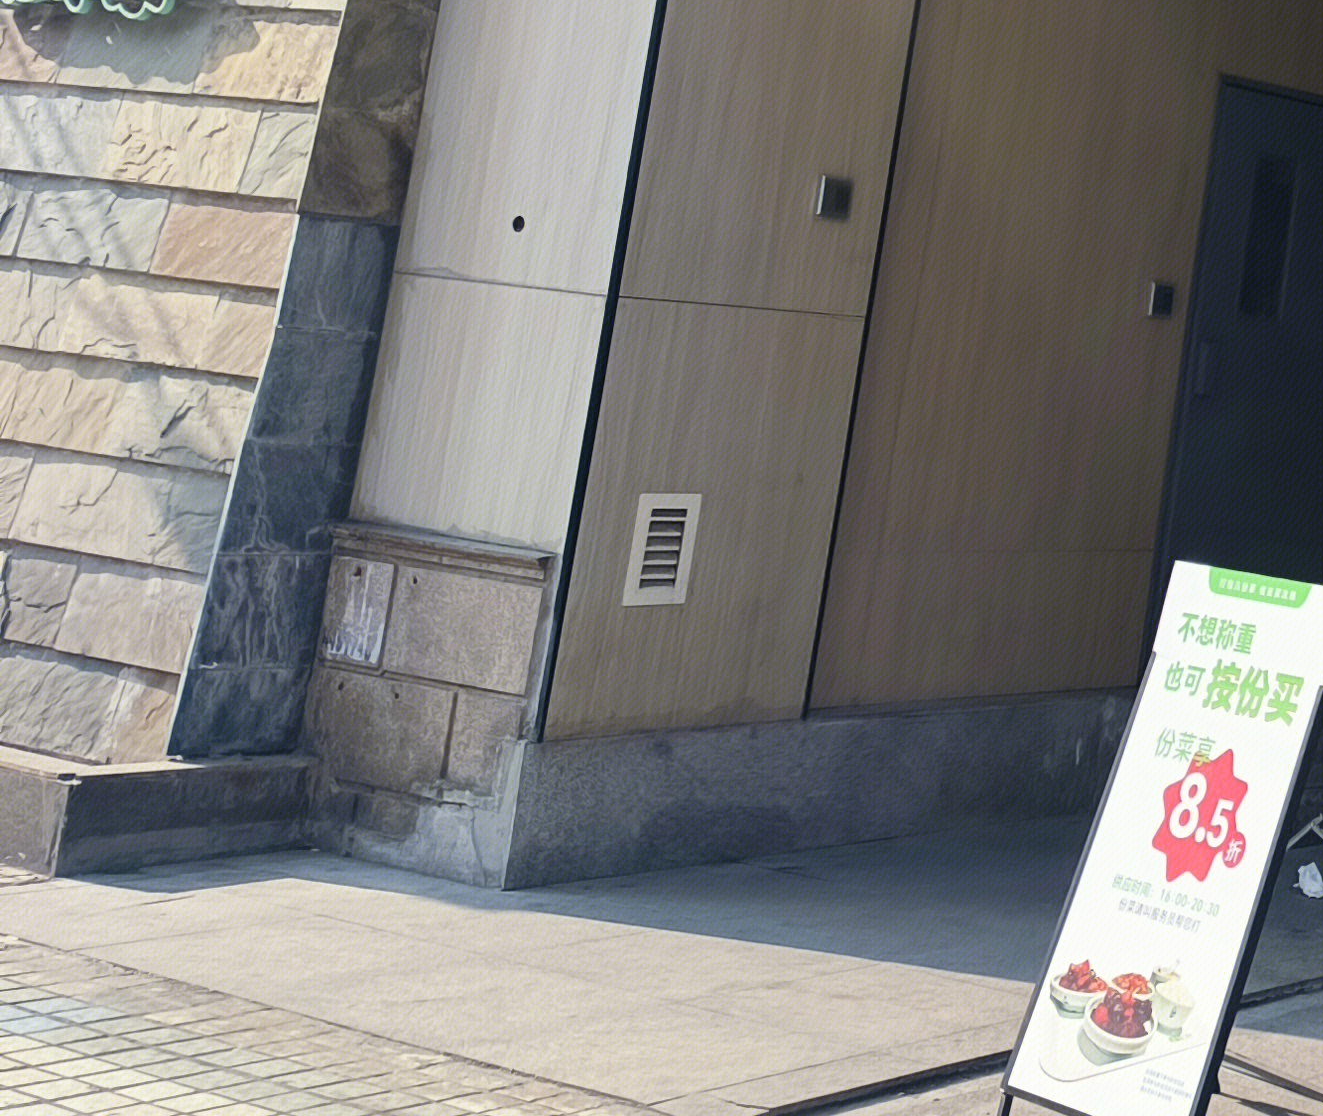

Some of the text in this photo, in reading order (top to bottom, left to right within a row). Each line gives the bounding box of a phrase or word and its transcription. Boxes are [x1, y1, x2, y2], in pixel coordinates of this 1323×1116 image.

[1177, 611, 1257, 655] 不想称重
[1154, 726, 1217, 767] 份菜享
